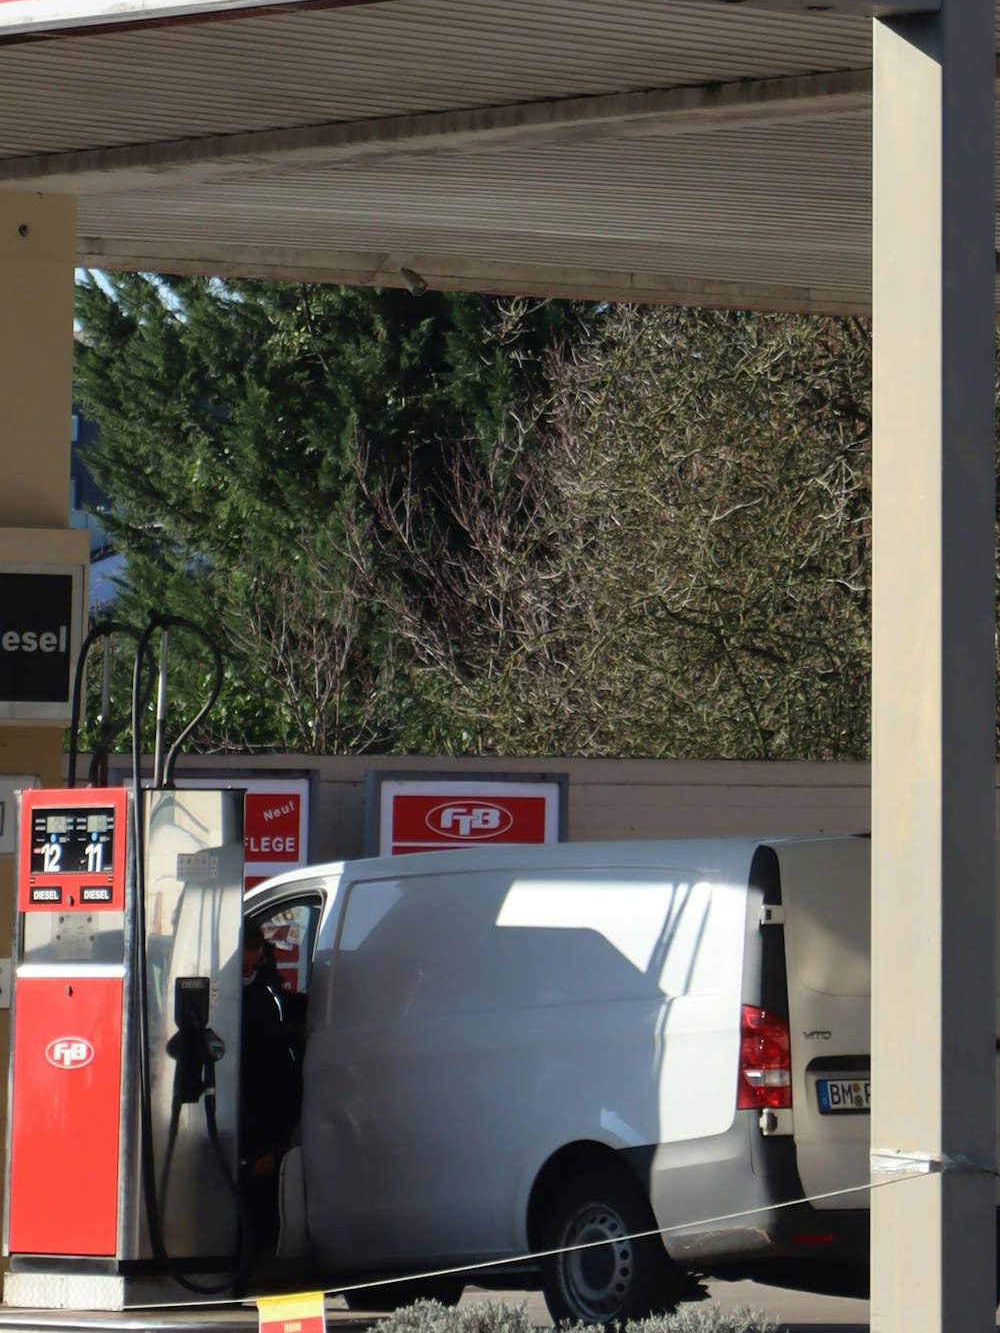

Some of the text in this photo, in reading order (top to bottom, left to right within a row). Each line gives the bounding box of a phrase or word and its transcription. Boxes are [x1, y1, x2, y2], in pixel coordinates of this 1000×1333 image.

[263, 800, 294, 822] Neu!
[440, 808, 500, 836] FTB
[41, 843, 62, 873] 12
[85, 843, 104, 873] 11
[33, 890, 59, 901] DIESEL
[83, 889, 110, 900] DIESEL
[802, 1030, 832, 1040] VITO
[53, 1043, 87, 1066] FTB
[830, 1083, 853, 1106] BM
